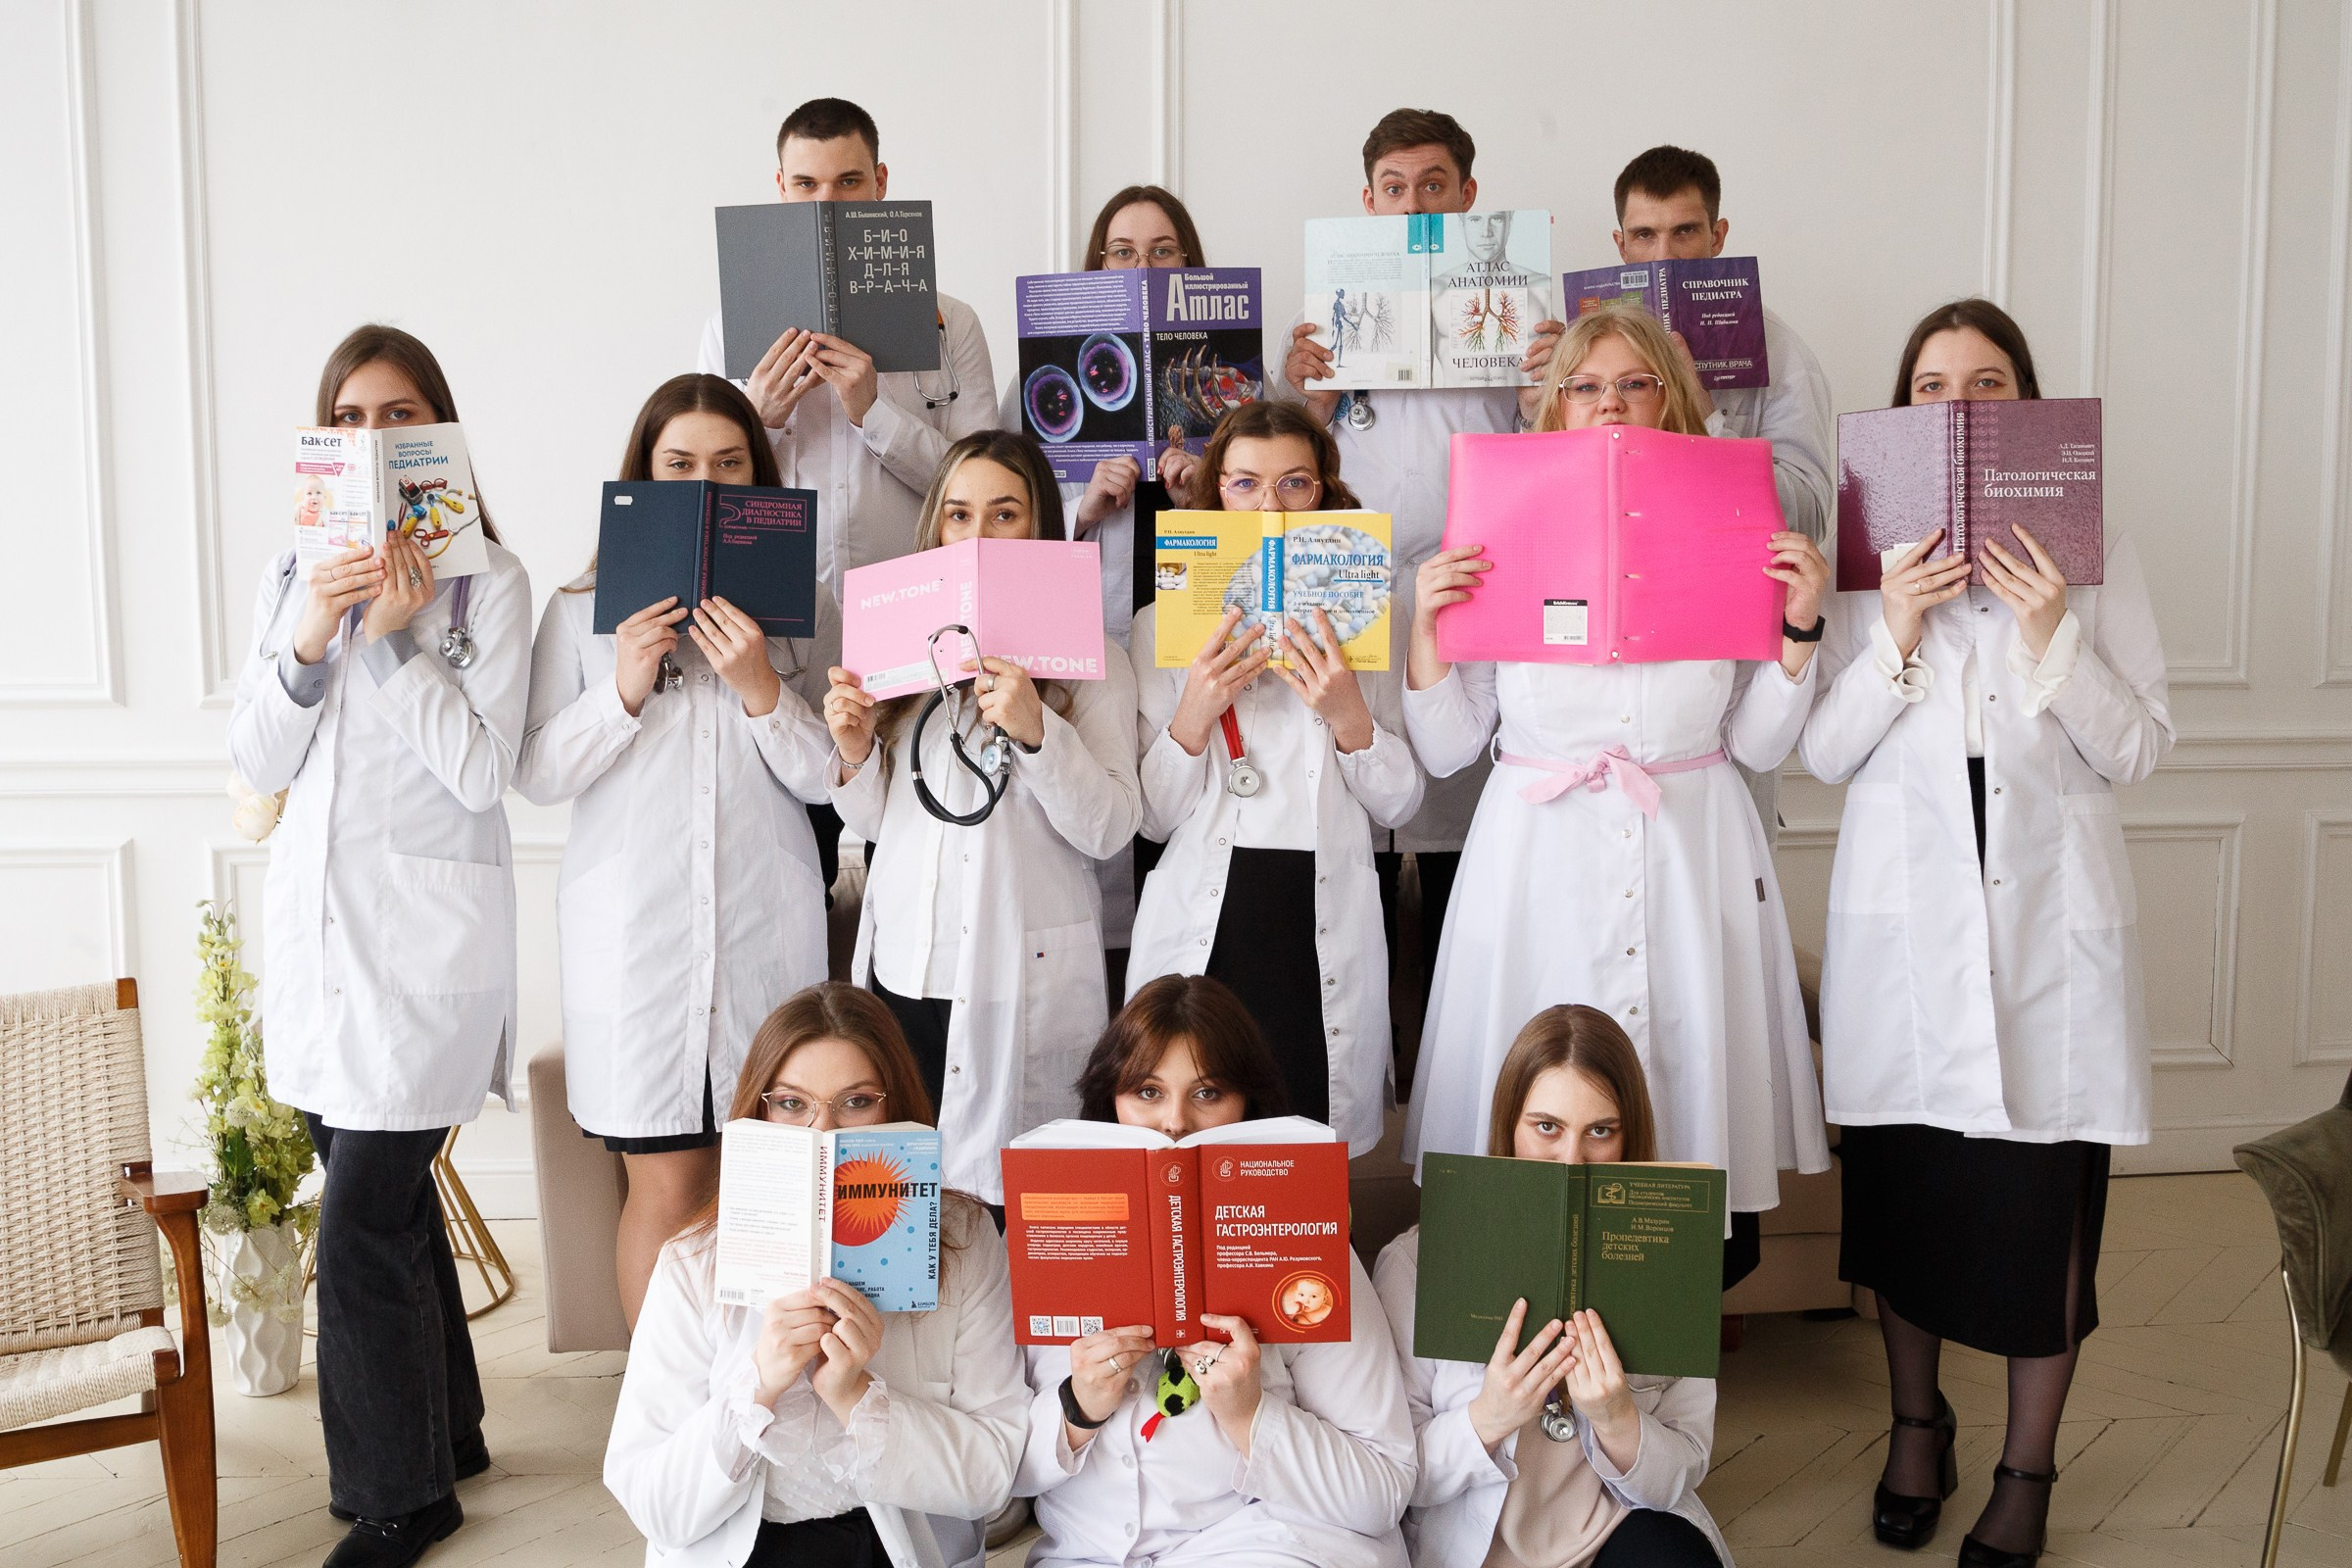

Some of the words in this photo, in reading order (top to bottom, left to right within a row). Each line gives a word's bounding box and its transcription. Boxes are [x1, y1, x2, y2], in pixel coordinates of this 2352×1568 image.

[1466, 261, 1510, 273] АТЛАС
[1184, 272, 1214, 281] Большой
[1447, 274, 1528, 288] АНАТОМИИ
[1184, 281, 1249, 291] иллюстрированный
[1658, 268, 1670, 310] ПЕДИАТРА
[1682, 278, 1749, 290] СПРАВОЧНИК
[1141, 279, 1150, 320] ЧЕЛОВЕКА
[1166, 273, 1250, 322] Атлас
[1691, 291, 1742, 301] ПЕДИАТРА
[1142, 321, 1151, 343] ТЕЛО
[1156, 332, 1173, 341] ТЕЛО
[1174, 331, 1208, 340] ЧЕЛОВЕКА
[1144, 350, 1152, 371] АТЛАС
[1452, 356, 1524, 368] ЧЕЛОВЕКА
[1693, 361, 1729, 369] СПУТНИК
[1729, 360, 1753, 368] ВРАЧА
[1145, 372, 1154, 447] ИЛЛЮСТРИРОВАННЫЙ
[395, 441, 434, 450] ИЗБРАННЫЕ
[1953, 413, 1965, 466] биохимия
[398, 449, 432, 458] ВОПРОСЫ
[388, 456, 449, 469] ПЕДИАТРИИ
[1984, 468, 2096, 481] Патологическая
[1984, 483, 2064, 498] биохимия
[745, 500, 802, 511] СИНДРОМНАЯ
[1954, 467, 1965, 553] Патологическая
[742, 508, 802, 518] ДИАГНОСТИКА
[754, 516, 802, 526] ПЕДИАТРИИ
[1292, 554, 1384, 566] ФАРМАКОЛОГИЯ
[1339, 569, 1359, 579] Ultra
[1360, 569, 1379, 581] light
[860, 579, 942, 611] NEW.TONE
[983, 654, 1098, 673] EW.TONE
[1240, 1159, 1295, 1169] НАЦИОНАЛЬНОЕ
[1240, 1168, 1289, 1177] РУКОВОДСТВО
[818, 1146, 828, 1223] ИММУНИТЕТ
[837, 1182, 938, 1200] ИММУНИТЕТ
[929, 1201, 938, 1229] ДЕЛА?
[1168, 1195, 1182, 1232] ДЕТСКАЯ
[1215, 1205, 1265, 1220] ДЕТСКАЯ
[1216, 1222, 1338, 1237] ГАСТРОЭНТЕРОЛОГИЯ
[928, 1231, 937, 1252] ТЕБЯ
[1602, 1231, 1670, 1244] Пропедевтика
[1601, 1243, 1640, 1252] детских
[1601, 1250, 1644, 1262] болезней
[927, 1263, 937, 1280] КАК
[1171, 1235, 1186, 1321] ГАСТРОЭНТЕРОЛОГИЯ
